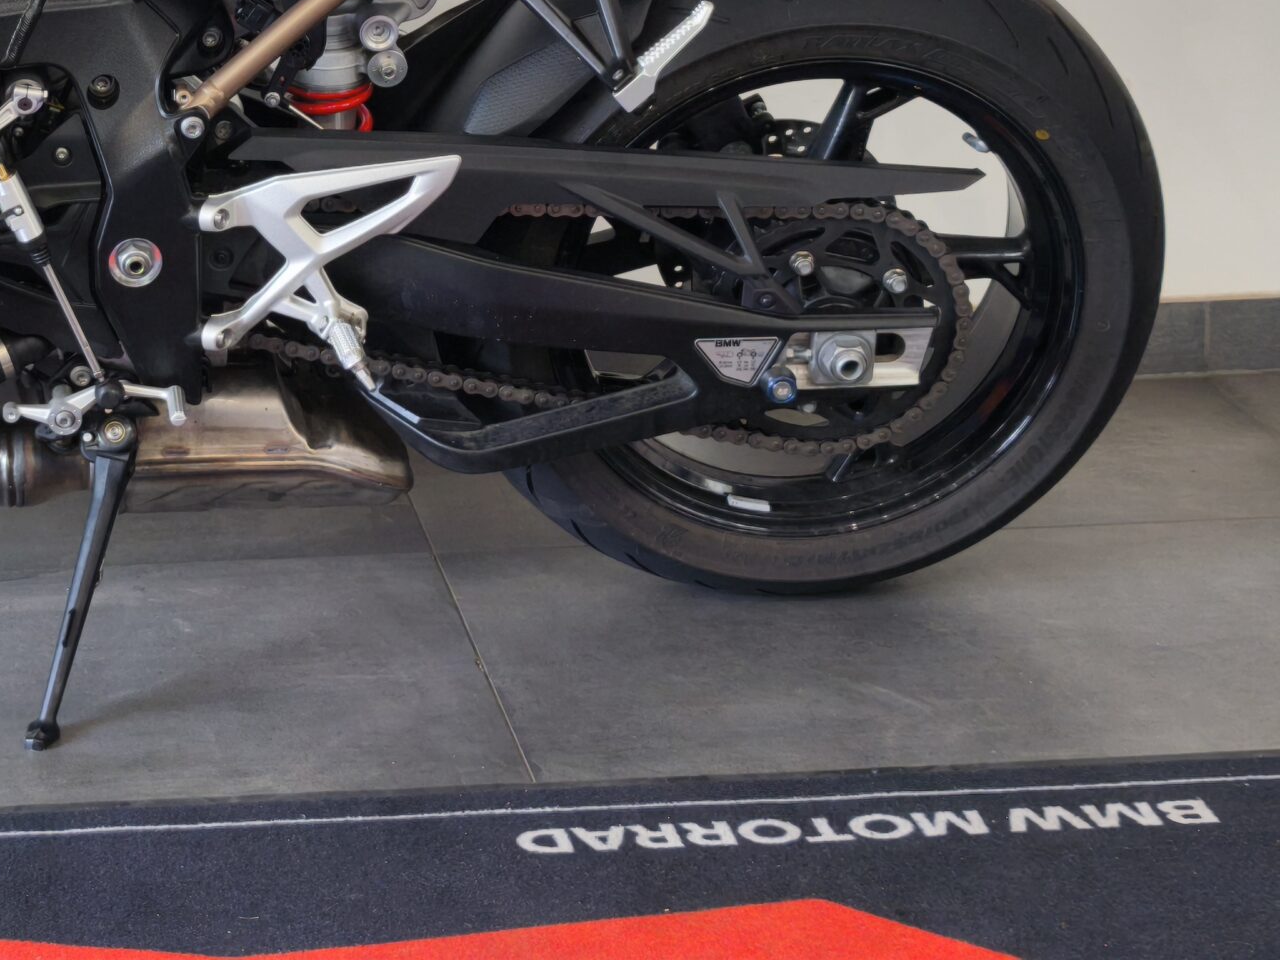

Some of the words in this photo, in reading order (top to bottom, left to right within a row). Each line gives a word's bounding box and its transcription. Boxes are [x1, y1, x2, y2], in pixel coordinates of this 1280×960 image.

[715, 339, 741, 347] BMW
[516, 809, 990, 854] MOTORRAD
[1009, 798, 1221, 833] BMW
